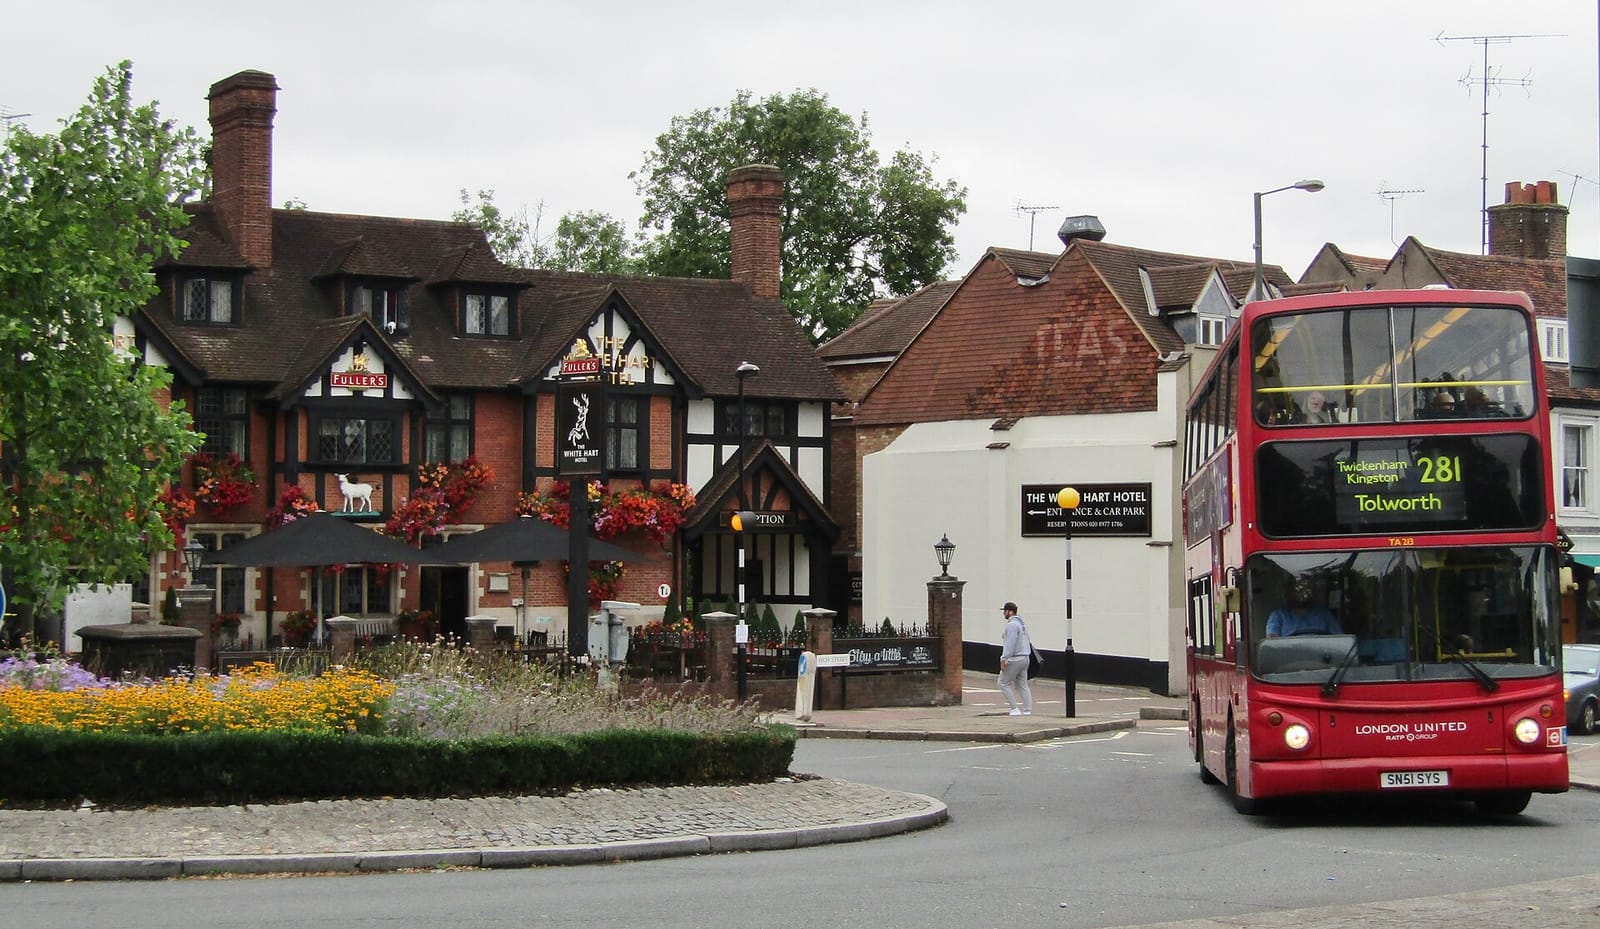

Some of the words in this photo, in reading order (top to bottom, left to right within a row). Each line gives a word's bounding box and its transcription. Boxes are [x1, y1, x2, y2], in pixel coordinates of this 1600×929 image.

[596, 336, 624, 350] THE
[563, 360, 597, 372] FULLER'S
[618, 354, 657, 369] HART
[333, 374, 384, 386] FULLER'S
[583, 449, 599, 457] HART
[1337, 460, 1408, 472] Twickenham
[1417, 455, 1461, 483] 281
[1347, 473, 1399, 485] Kingston
[1026, 493, 1046, 503] THE
[1083, 492, 1110, 503] HART
[1113, 491, 1147, 502] HOTEL
[1354, 493, 1442, 511] Tolworth
[1046, 507, 1093, 516] ENTNCE
[1094, 507, 1102, 516] &
[1103, 507, 1121, 516] CAR
[1122, 506, 1145, 516] PARK
[1355, 723, 1409, 735] LONDON
[1414, 721, 1467, 732] UNITED
[1387, 773, 1414, 785] SN51
[1417, 772, 1440, 784] SYS
